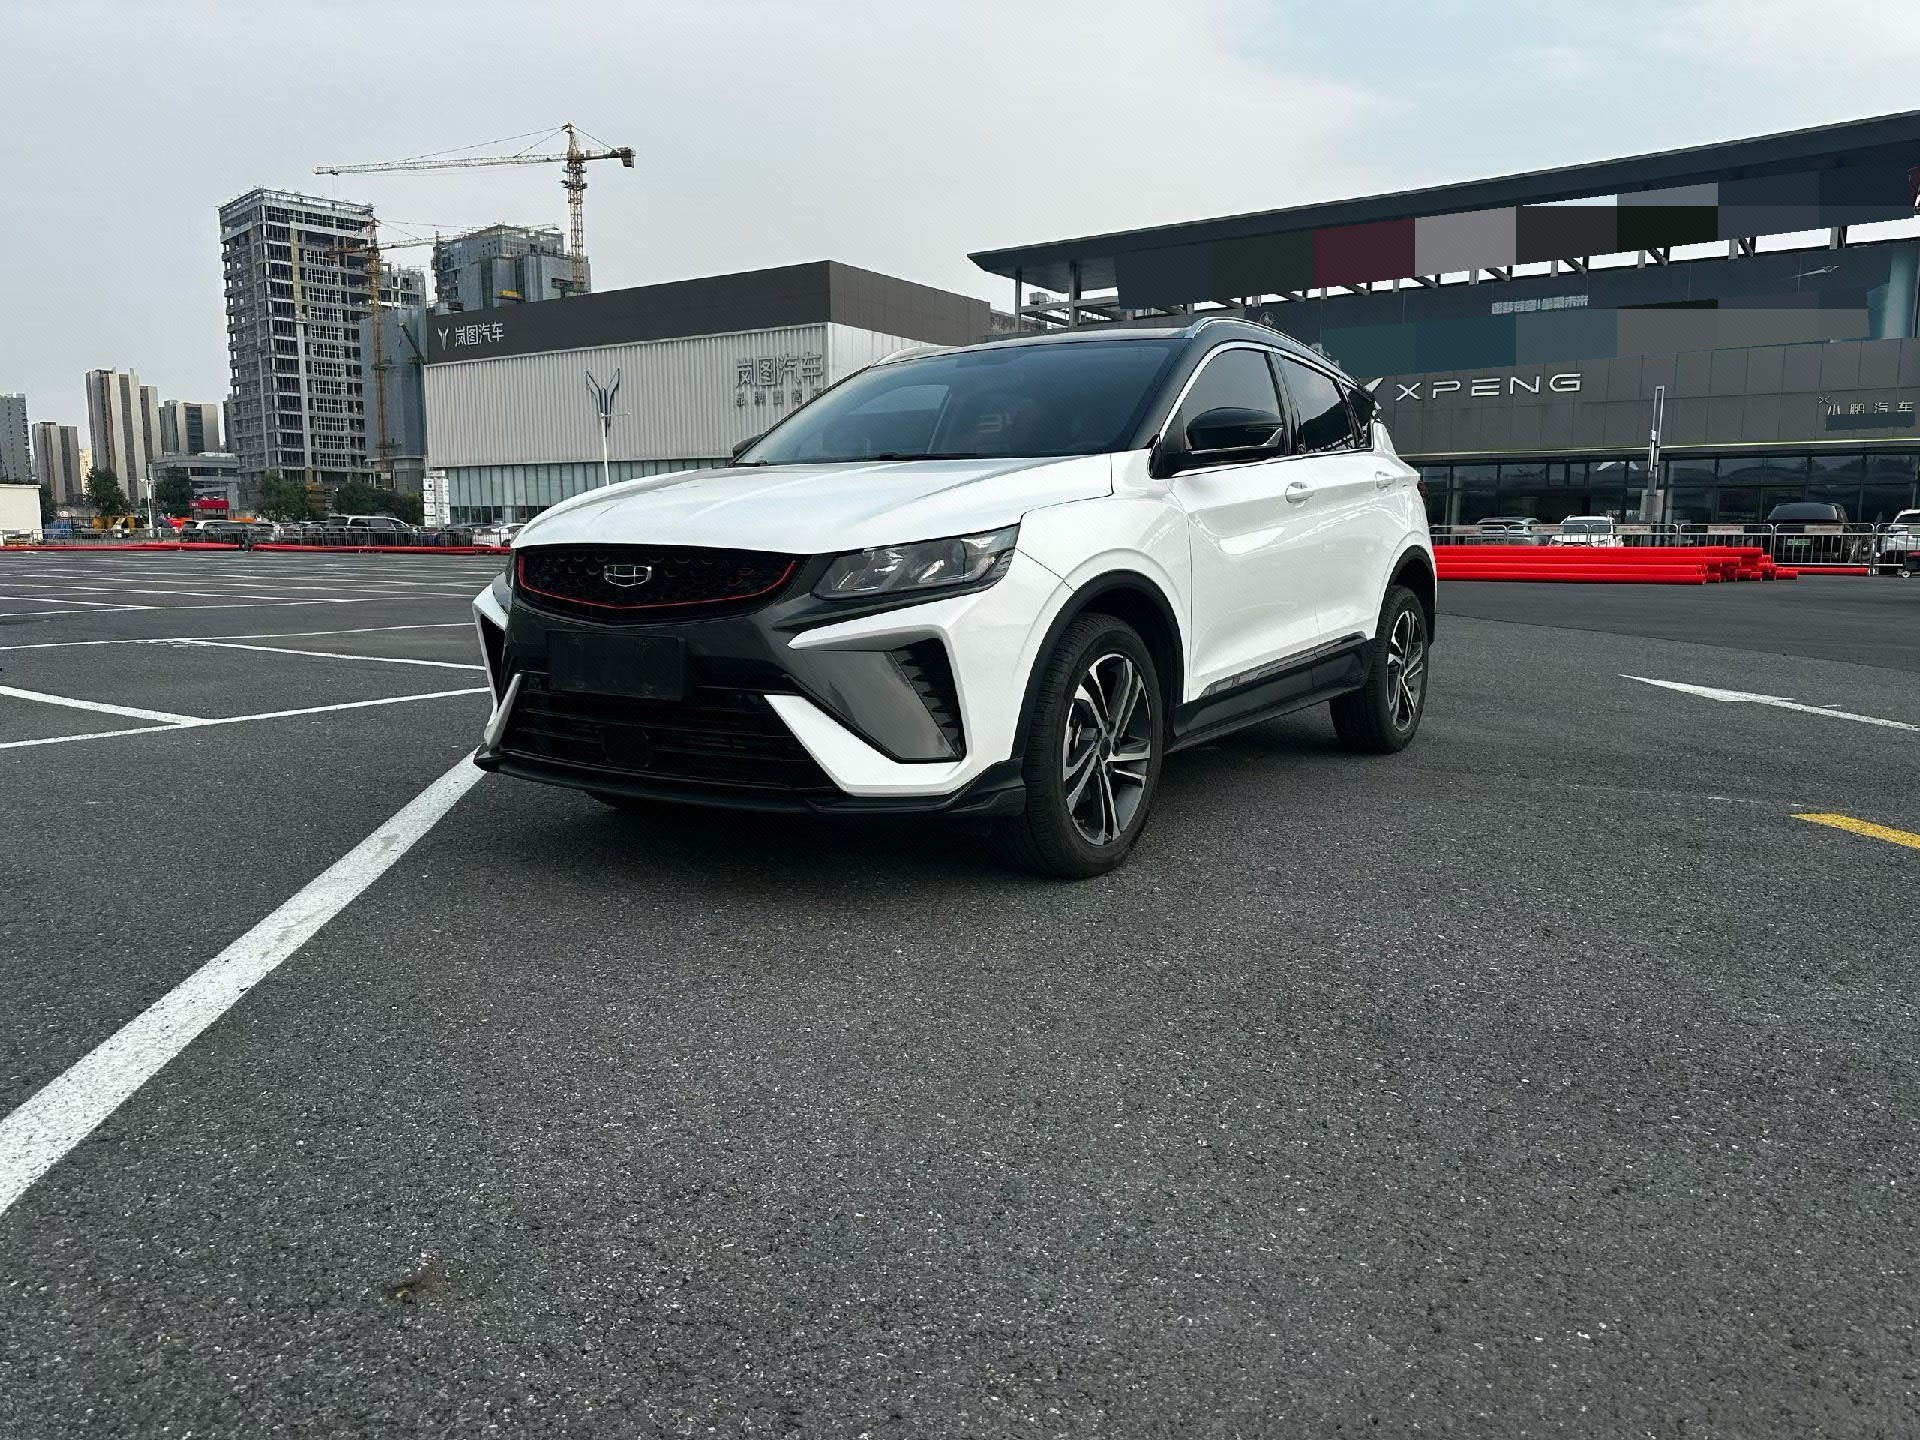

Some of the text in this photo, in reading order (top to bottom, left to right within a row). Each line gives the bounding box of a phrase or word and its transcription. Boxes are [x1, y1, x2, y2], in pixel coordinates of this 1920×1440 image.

[455, 321, 504, 347] 岚图汽车
[736, 352, 823, 388] 岚图汽车
[1396, 373, 1581, 401] XPENG
